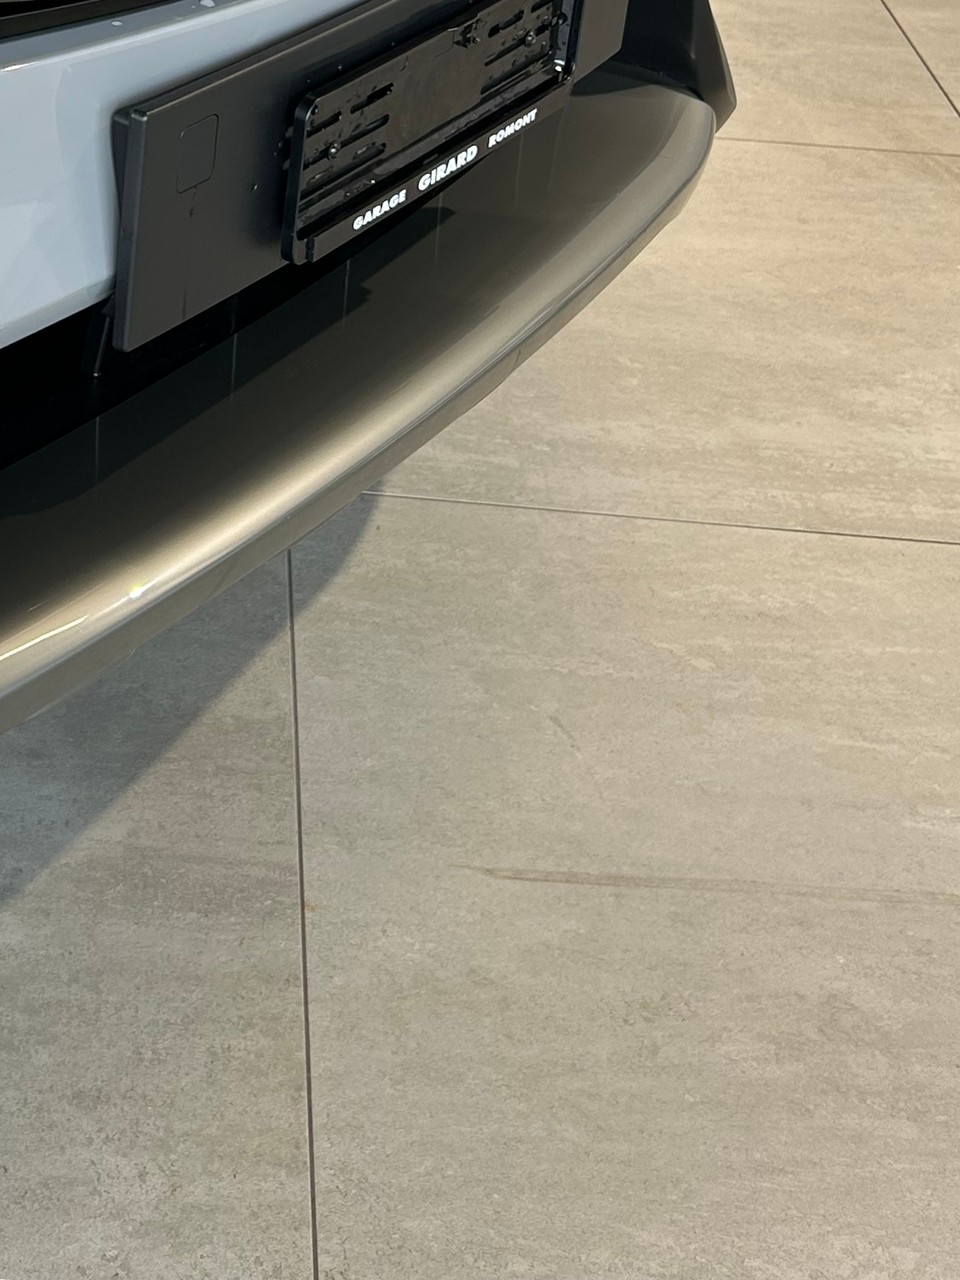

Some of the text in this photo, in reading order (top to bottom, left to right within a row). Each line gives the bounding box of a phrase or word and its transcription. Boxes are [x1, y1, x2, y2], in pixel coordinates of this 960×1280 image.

[352, 108, 538, 230] GARAGE GIRARD ROMONT
